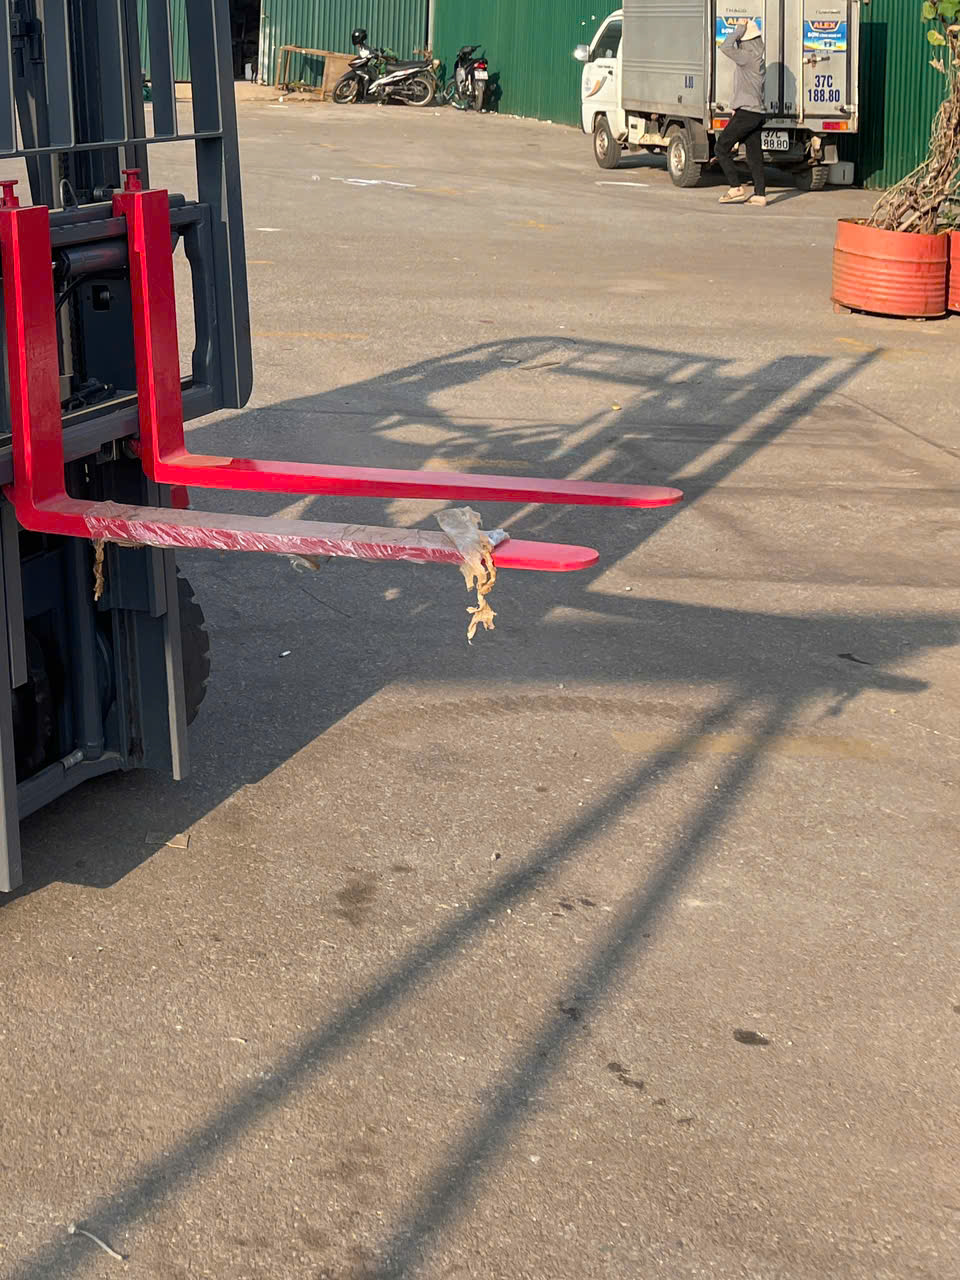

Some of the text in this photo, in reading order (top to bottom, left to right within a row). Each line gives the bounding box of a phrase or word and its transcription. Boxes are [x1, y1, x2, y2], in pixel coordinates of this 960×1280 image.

[813, 21, 836, 29] ALEX
[814, 74, 833, 88] 37C
[807, 88, 840, 102] 188.80
[764, 130, 781, 139] 37C
